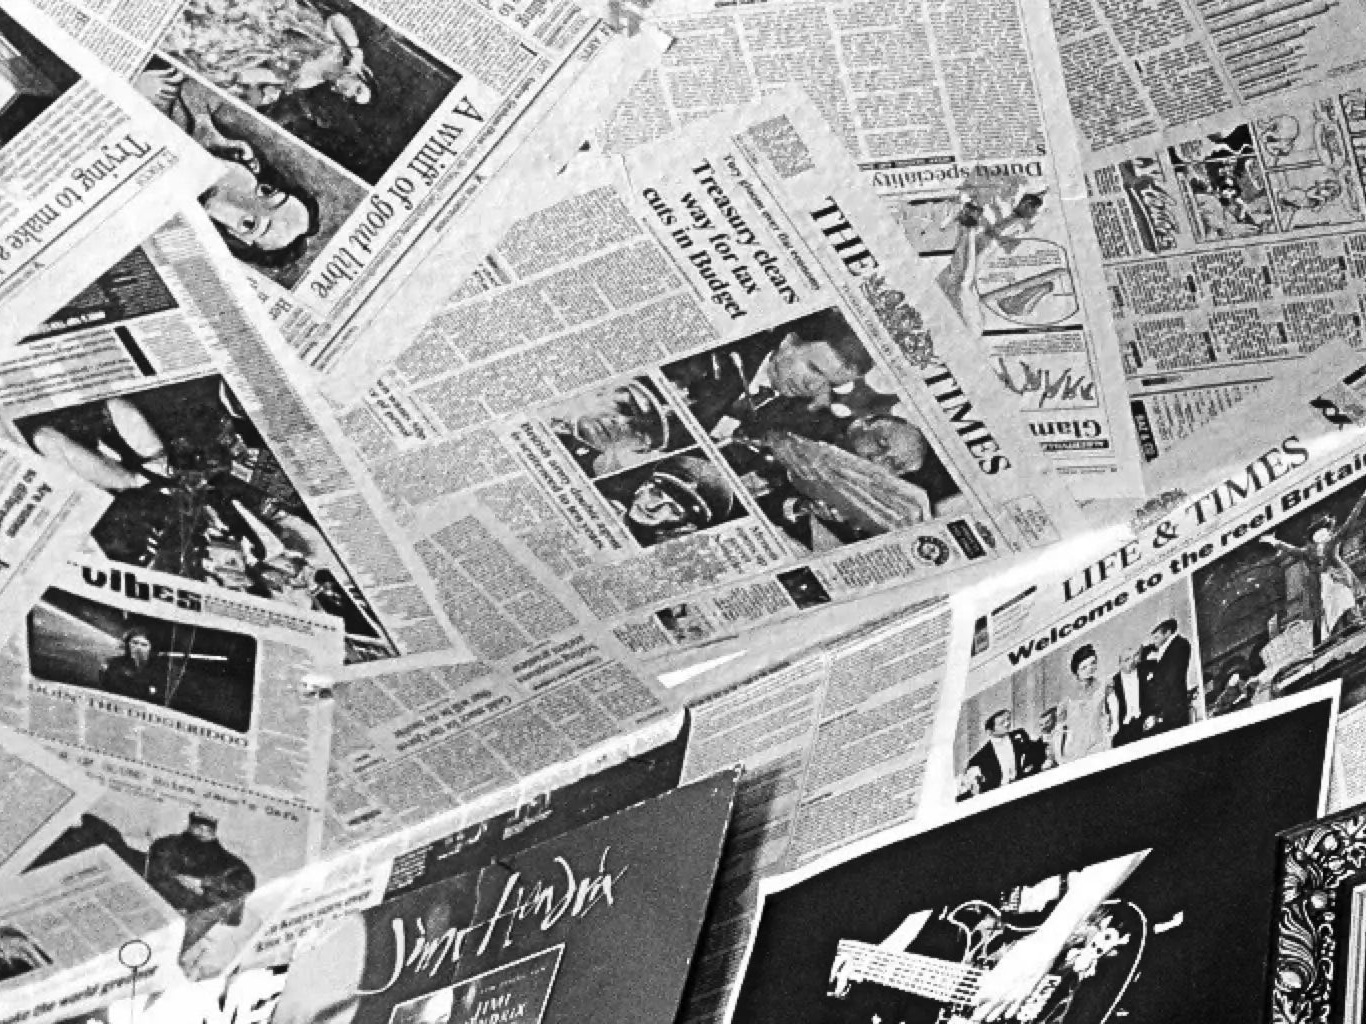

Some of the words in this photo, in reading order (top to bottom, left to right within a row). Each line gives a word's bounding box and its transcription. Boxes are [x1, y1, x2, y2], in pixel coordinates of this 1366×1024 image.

[453, 96, 483, 122] A
[71, 134, 151, 192] Trying
[407, 124, 463, 186] whiff
[55, 187, 83, 208] to
[387, 178, 415, 210] of
[5, 204, 61, 249] make
[349, 194, 393, 254] gout
[681, 192, 715, 229] way
[709, 234, 739, 260] for
[731, 266, 760, 294] tax
[693, 160, 759, 244] Treasury
[753, 250, 799, 304] clears
[311, 248, 365, 298] libre
[643, 188, 677, 225] cuts
[672, 228, 693, 248] in
[689, 250, 747, 320] Budget
[810, 196, 879, 276] THE
[925, 363, 1011, 474] TIMES
[1029, 420, 1102, 443] Glam
[1063, 540, 1141, 602] LIFE
[1143, 521, 1178, 548] &
[1180, 435, 1308, 526] TIMES
[1008, 587, 1131, 668] Welcome
[1135, 573, 1163, 594] to
[1169, 544, 1213, 574] the
[1221, 504, 1273, 546] reel
[473, 991, 511, 1016] JIMI
